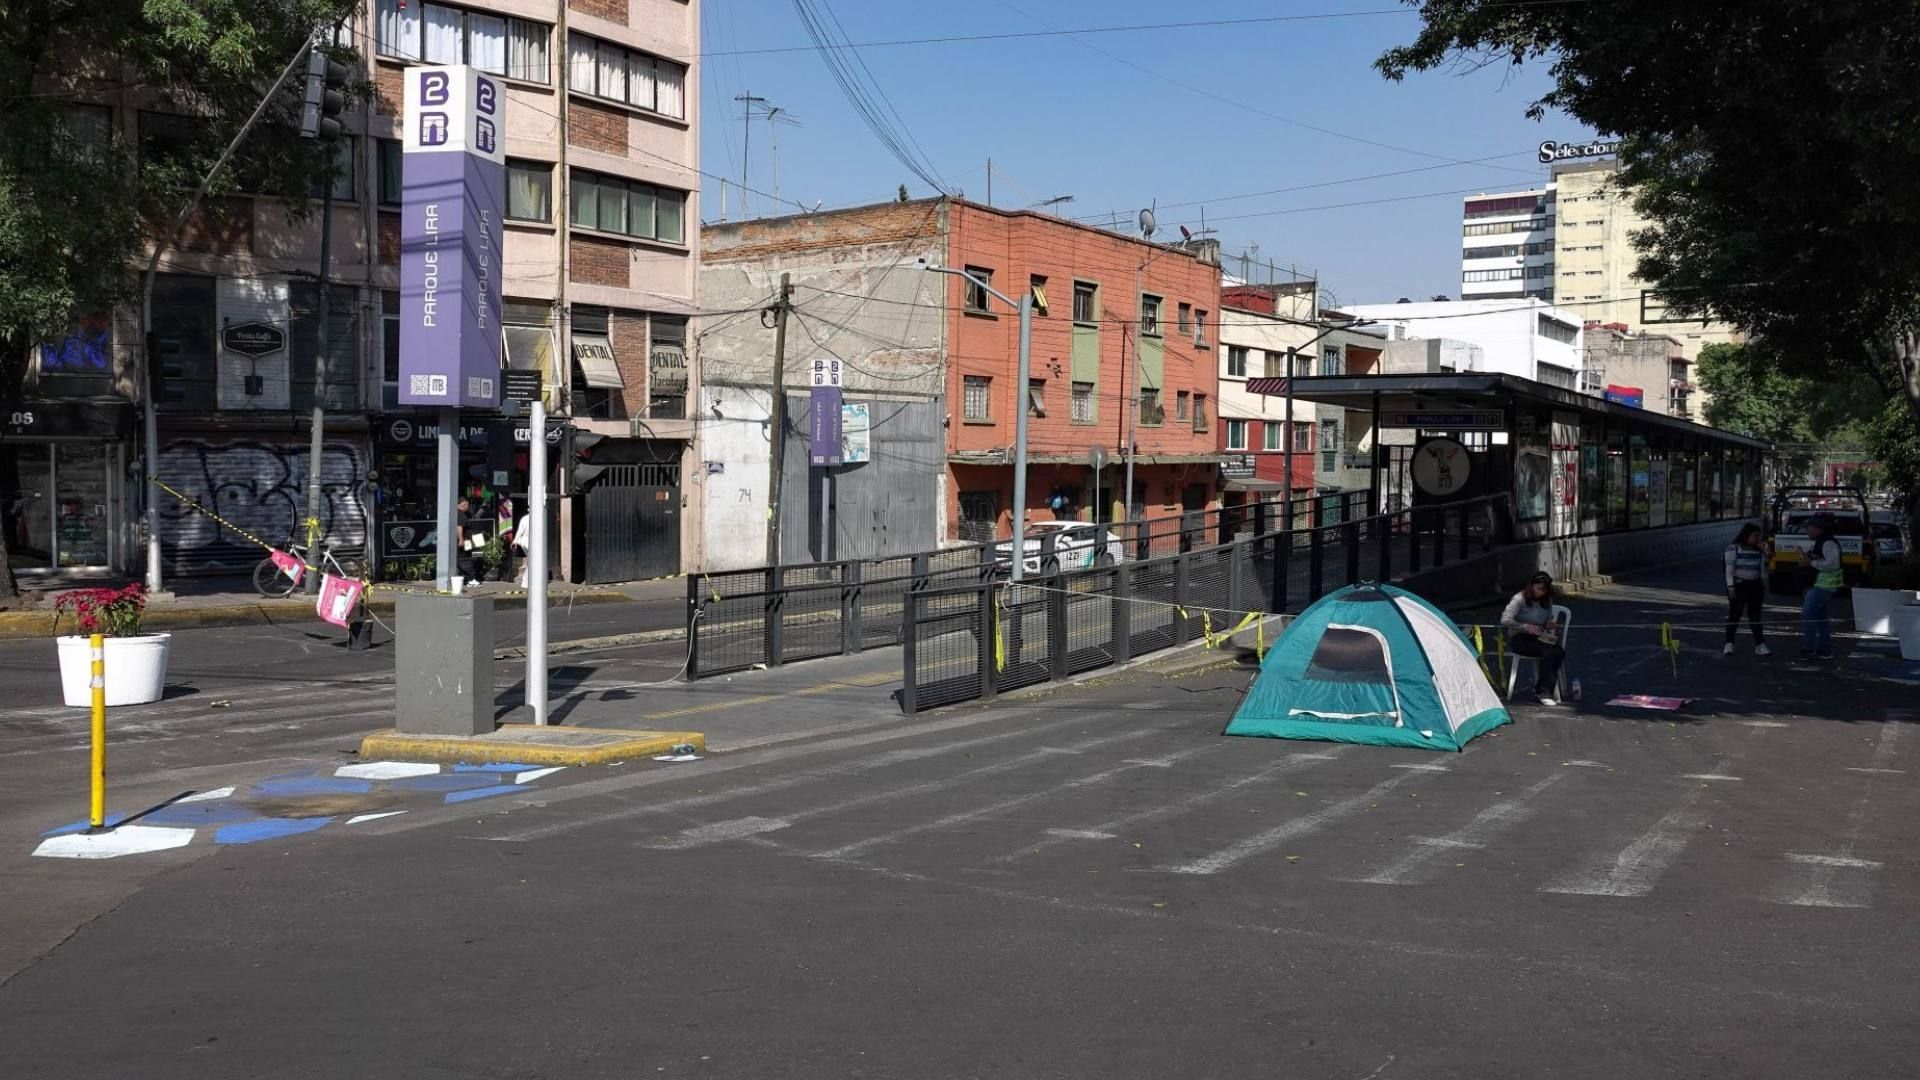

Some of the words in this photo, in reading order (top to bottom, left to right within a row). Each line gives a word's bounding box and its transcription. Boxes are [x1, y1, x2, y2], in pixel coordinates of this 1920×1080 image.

[425, 204, 439, 246] LIRA
[479, 209, 490, 249] LIRA
[424, 251, 438, 327] PARQUE
[478, 255, 489, 329] PARQUE
[576, 344, 612, 361] DENTAL
[737, 487, 748, 500] 74
